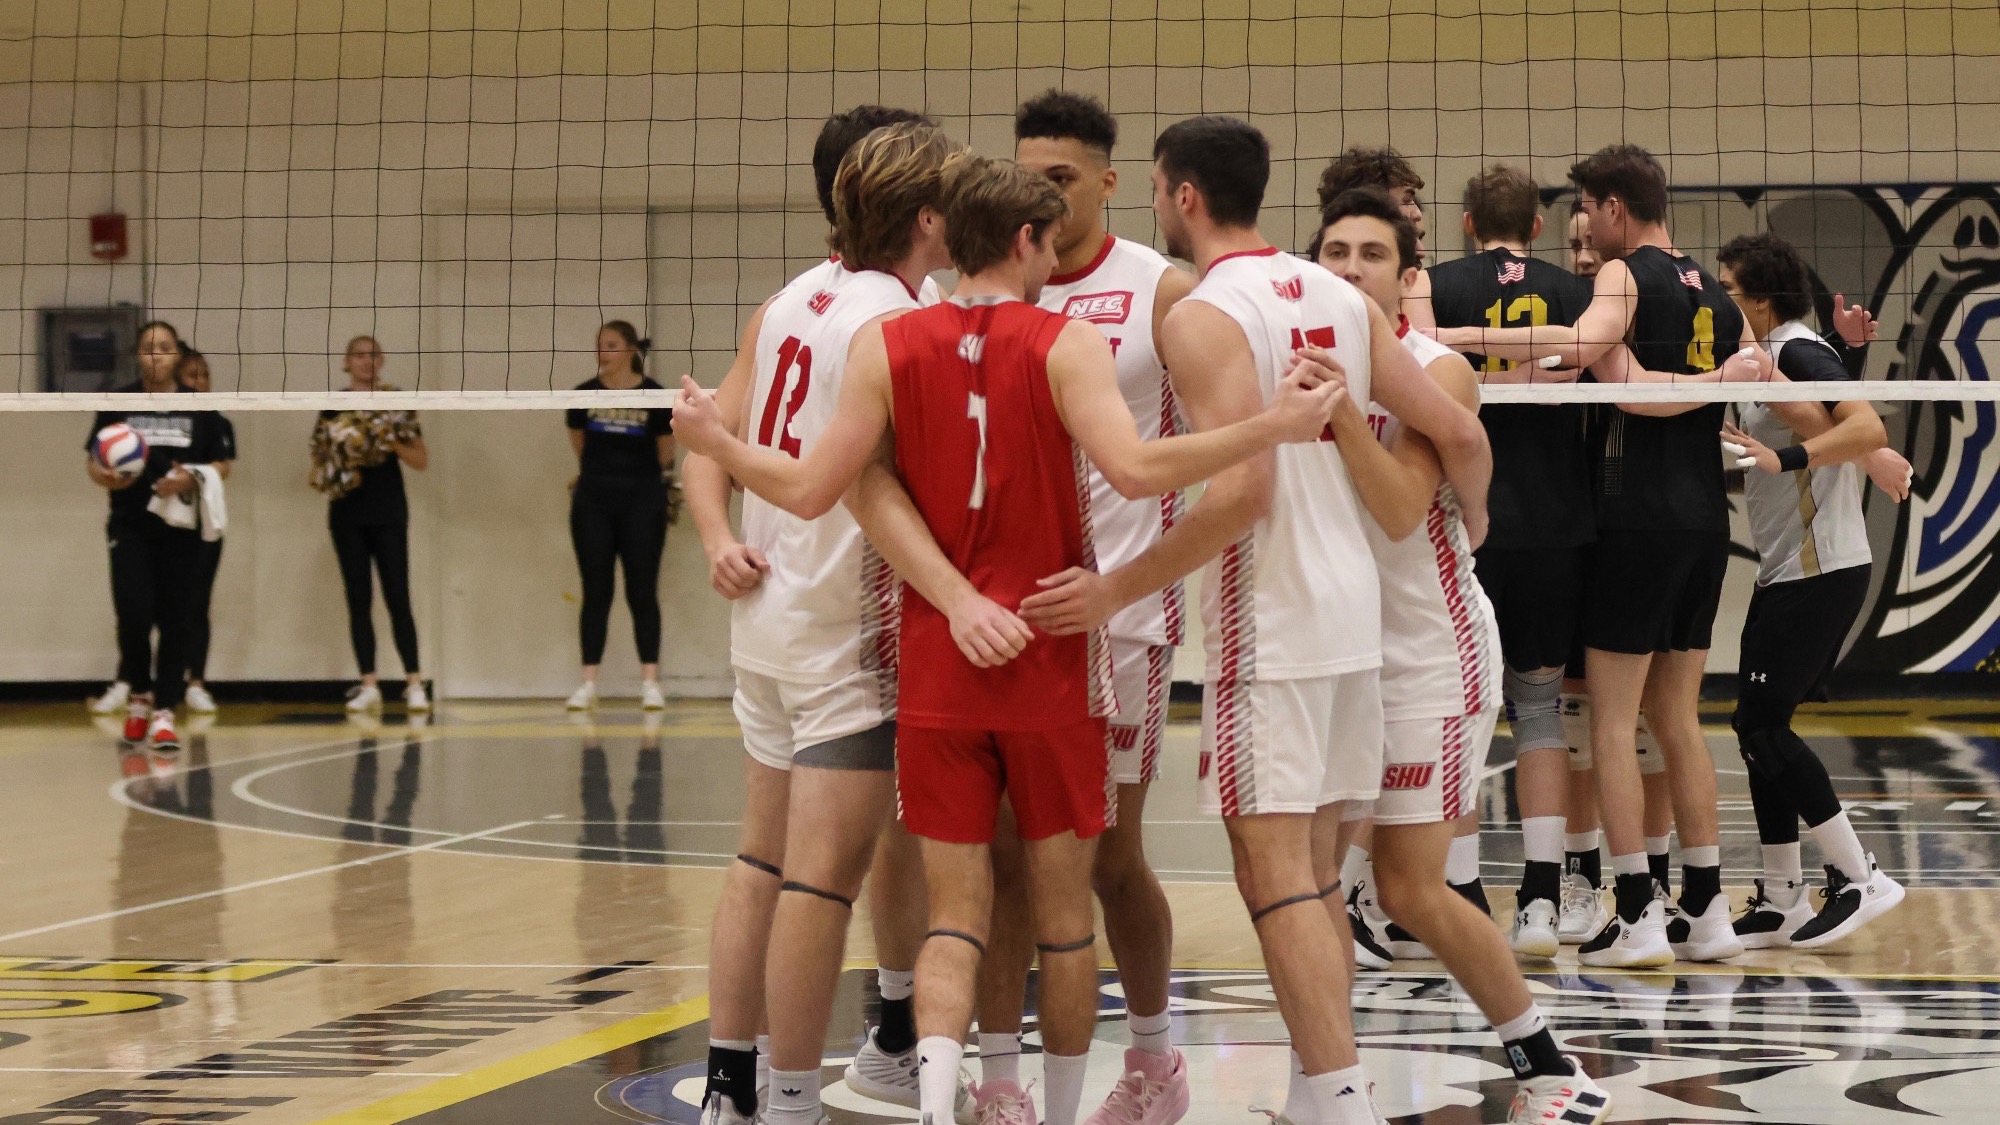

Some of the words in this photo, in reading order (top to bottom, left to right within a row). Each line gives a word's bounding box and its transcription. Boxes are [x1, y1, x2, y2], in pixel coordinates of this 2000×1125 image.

[1066, 294, 1126, 318] NEC
[758, 335, 812, 460] 12
[1109, 724, 1141, 752] HU
[1381, 762, 1436, 791] SHU
[136, 989, 633, 1080] WAYNE
